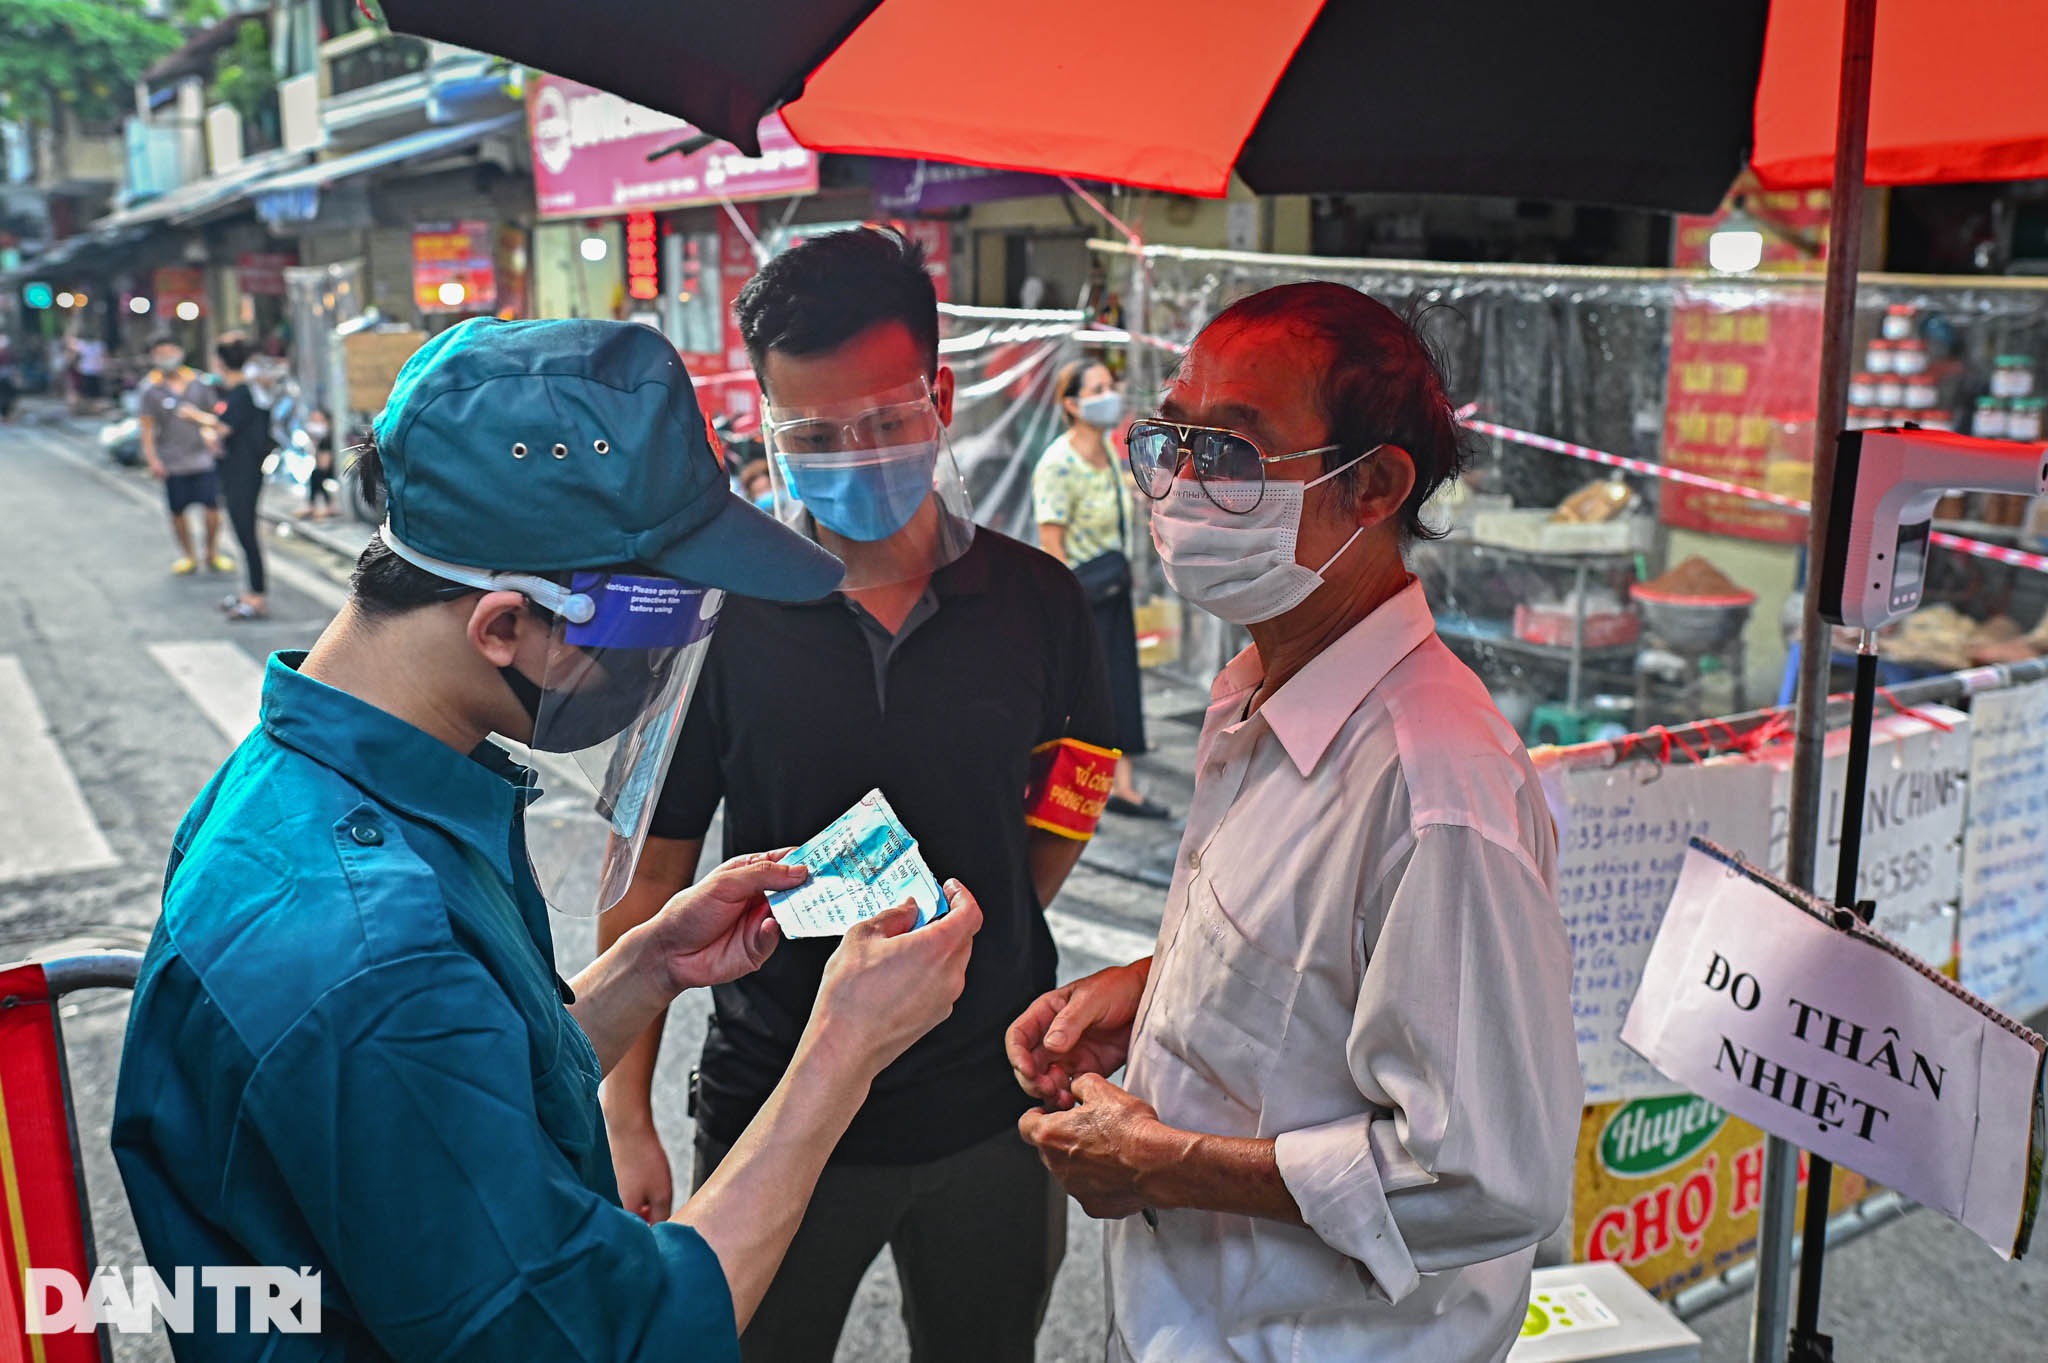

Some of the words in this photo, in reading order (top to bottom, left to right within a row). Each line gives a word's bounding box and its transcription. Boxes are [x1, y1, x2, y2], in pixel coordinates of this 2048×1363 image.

[632, 585, 657, 595] Please
[659, 588, 679, 597] gently
[631, 595, 666, 605] protective
[630, 604, 653, 613] before
[654, 606, 673, 614] using
[1703, 950, 1761, 1012] ĐO
[1788, 997, 1948, 1102] THÂN
[1713, 1033, 1890, 1144] NHIỆT
